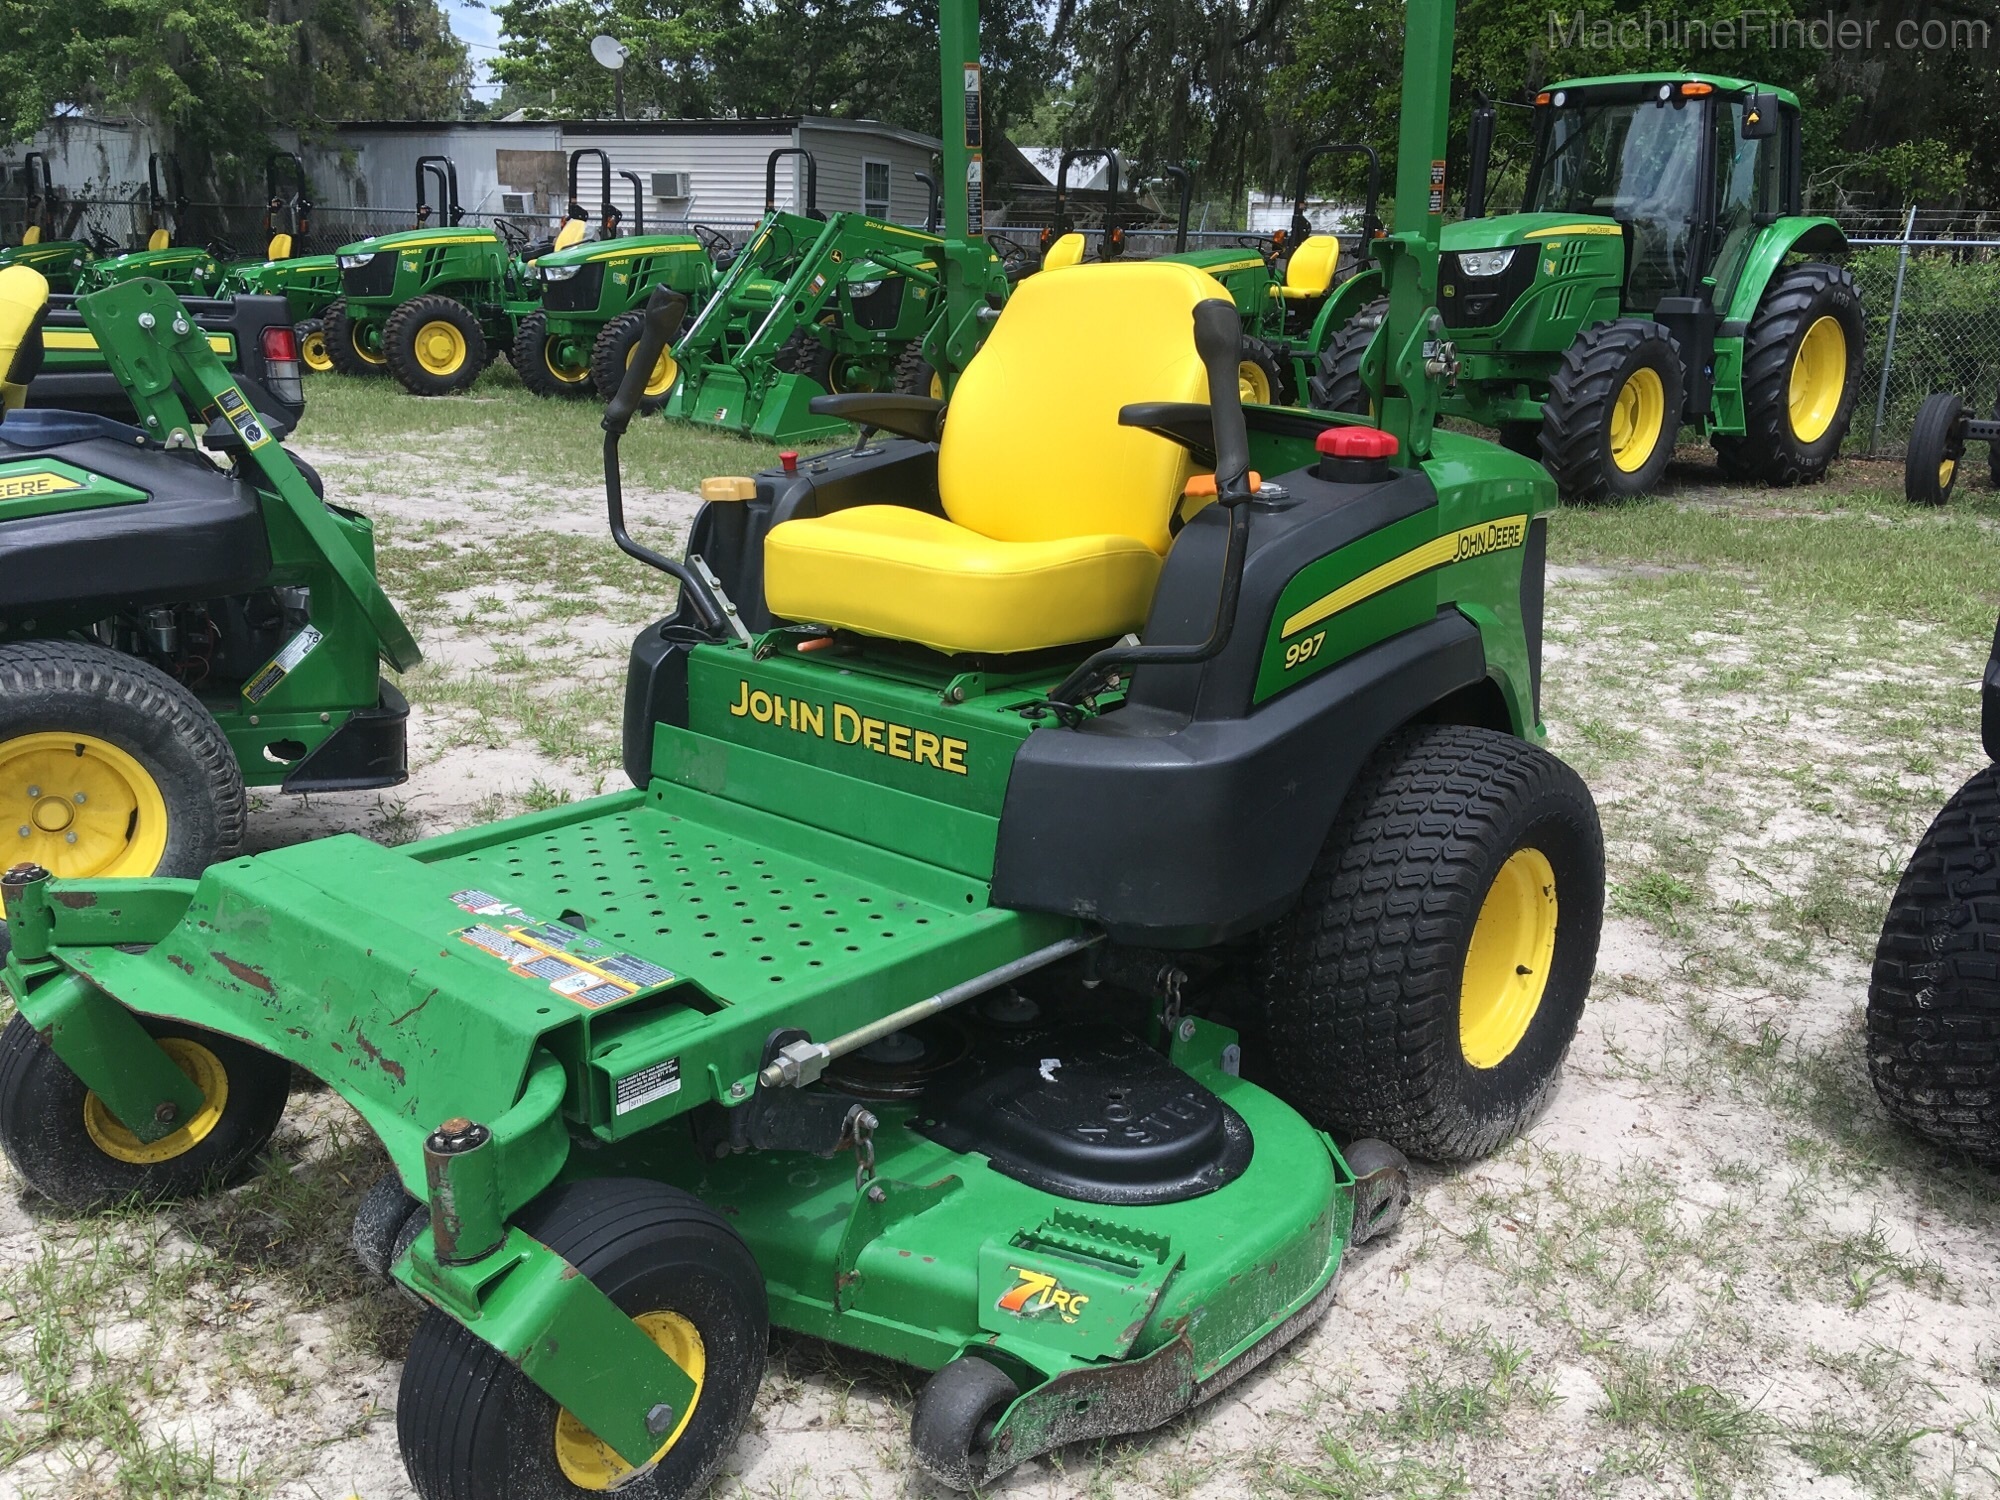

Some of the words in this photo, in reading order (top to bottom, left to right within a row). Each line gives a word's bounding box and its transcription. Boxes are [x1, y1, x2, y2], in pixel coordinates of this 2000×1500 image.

[1453, 532, 1486, 561] JOHN
[1488, 524, 1520, 549] DEERE
[1284, 630, 1326, 670] 997
[730, 679, 825, 737] JOHN
[832, 702, 968, 776] DEERE
